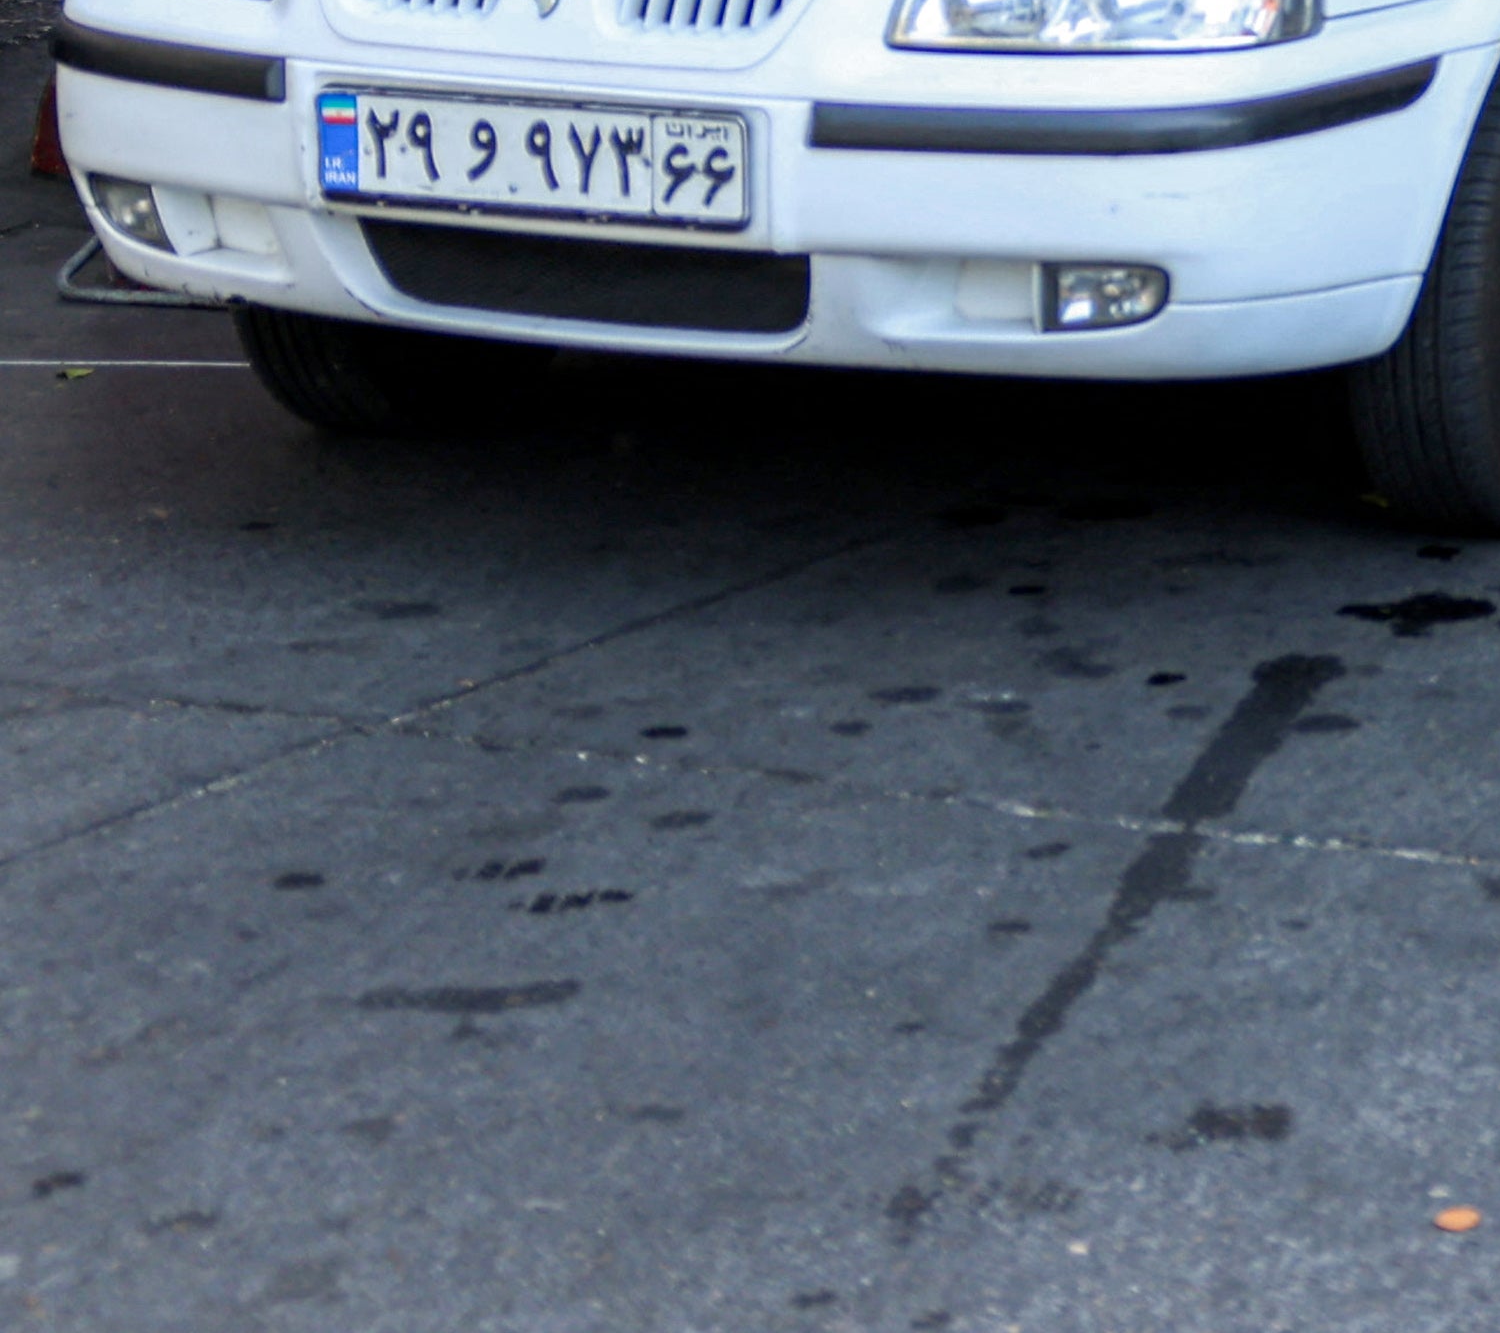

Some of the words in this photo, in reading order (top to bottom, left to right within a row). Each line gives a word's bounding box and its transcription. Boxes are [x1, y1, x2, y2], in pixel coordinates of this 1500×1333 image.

[325, 171, 356, 184] IRAN
[365, 109, 440, 181] ۲۹
[468, 119, 497, 180] و
[525, 120, 645, 197] ۹۷۳
[661, 144, 736, 206] ۶۶
